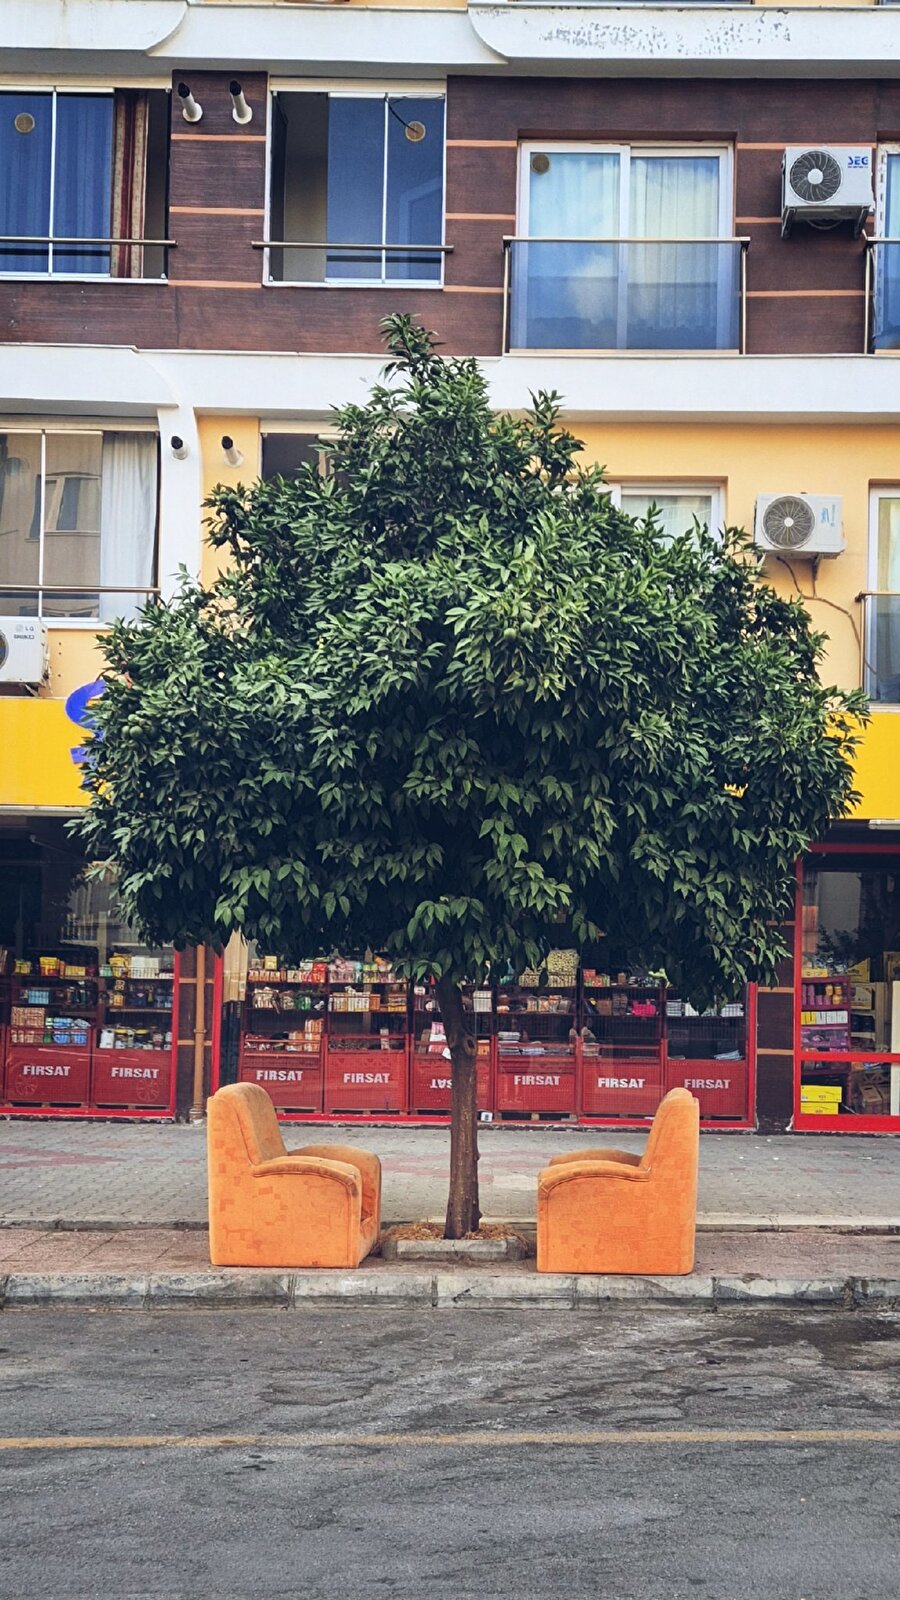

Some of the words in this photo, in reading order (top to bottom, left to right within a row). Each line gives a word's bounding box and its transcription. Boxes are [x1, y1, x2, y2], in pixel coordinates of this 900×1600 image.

[847, 156, 868, 165] SEG
[23, 1065, 70, 1076] FIRSAT
[110, 1066, 159, 1079] FIRSAT
[256, 1070, 303, 1081] FIRSAT
[343, 1072, 390, 1084] FIRSAT
[513, 1074, 561, 1086] FIRSAT
[597, 1077, 646, 1089] FIRSAT
[684, 1078, 732, 1089] FIRSAT
